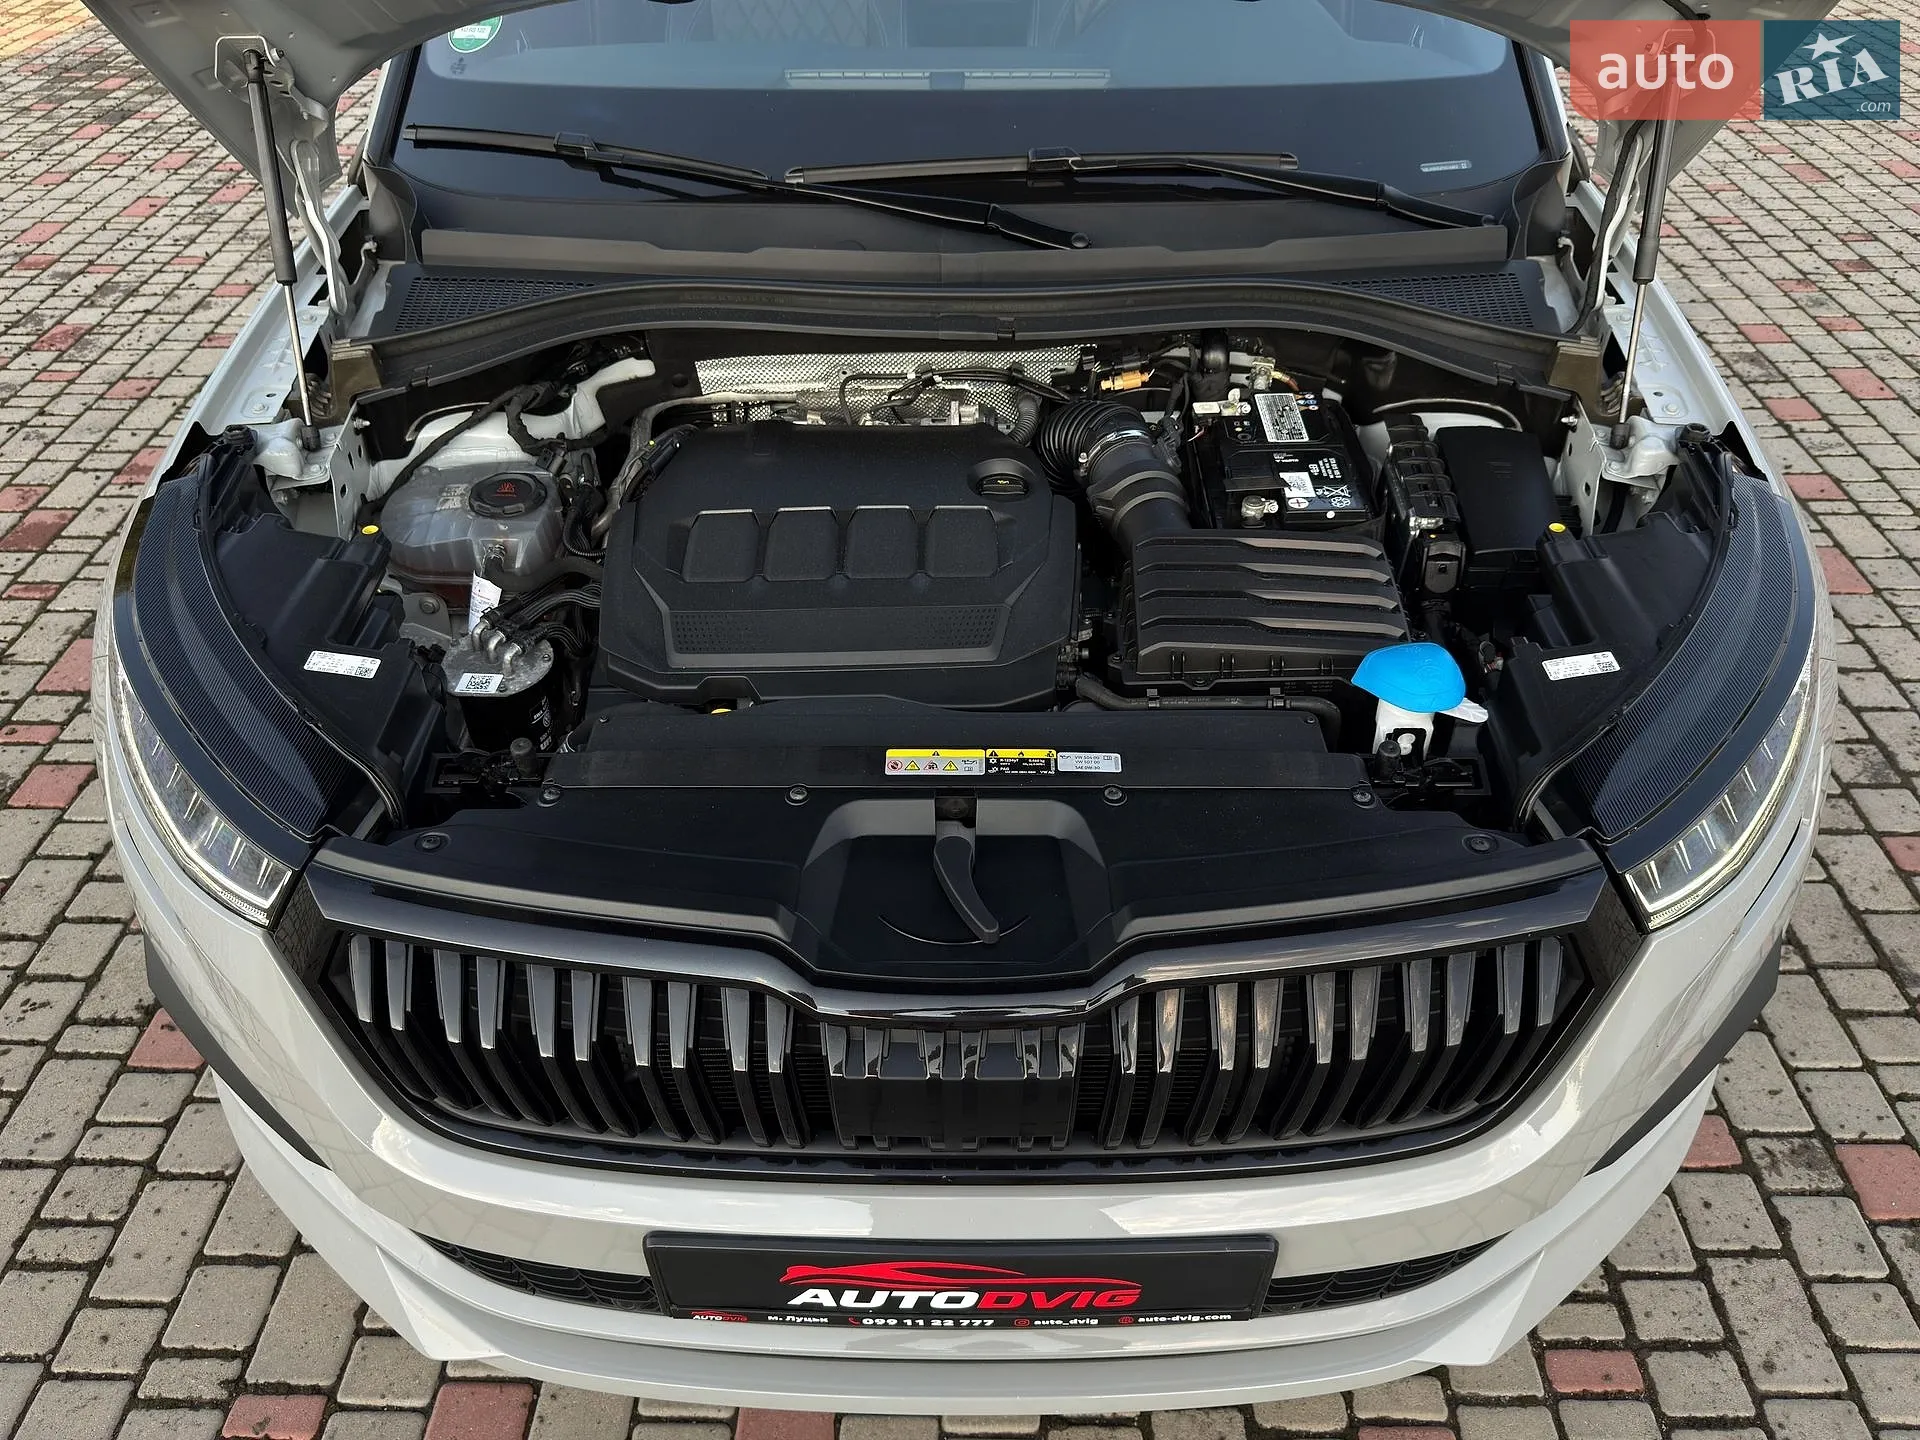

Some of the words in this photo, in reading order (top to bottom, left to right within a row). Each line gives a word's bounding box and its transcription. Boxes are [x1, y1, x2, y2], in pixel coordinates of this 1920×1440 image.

[787, 1288, 1142, 1309] AUTODVIG
[786, 1315, 830, 1324] Луцьк
[862, 1317, 903, 1326] 099
[907, 1317, 925, 1326] 11
[930, 1317, 958, 1326] 22
[960, 1318, 995, 1327] 777
[1034, 1317, 1099, 1326] auto_dvig
[1138, 1313, 1232, 1323] auto-dvig.com
